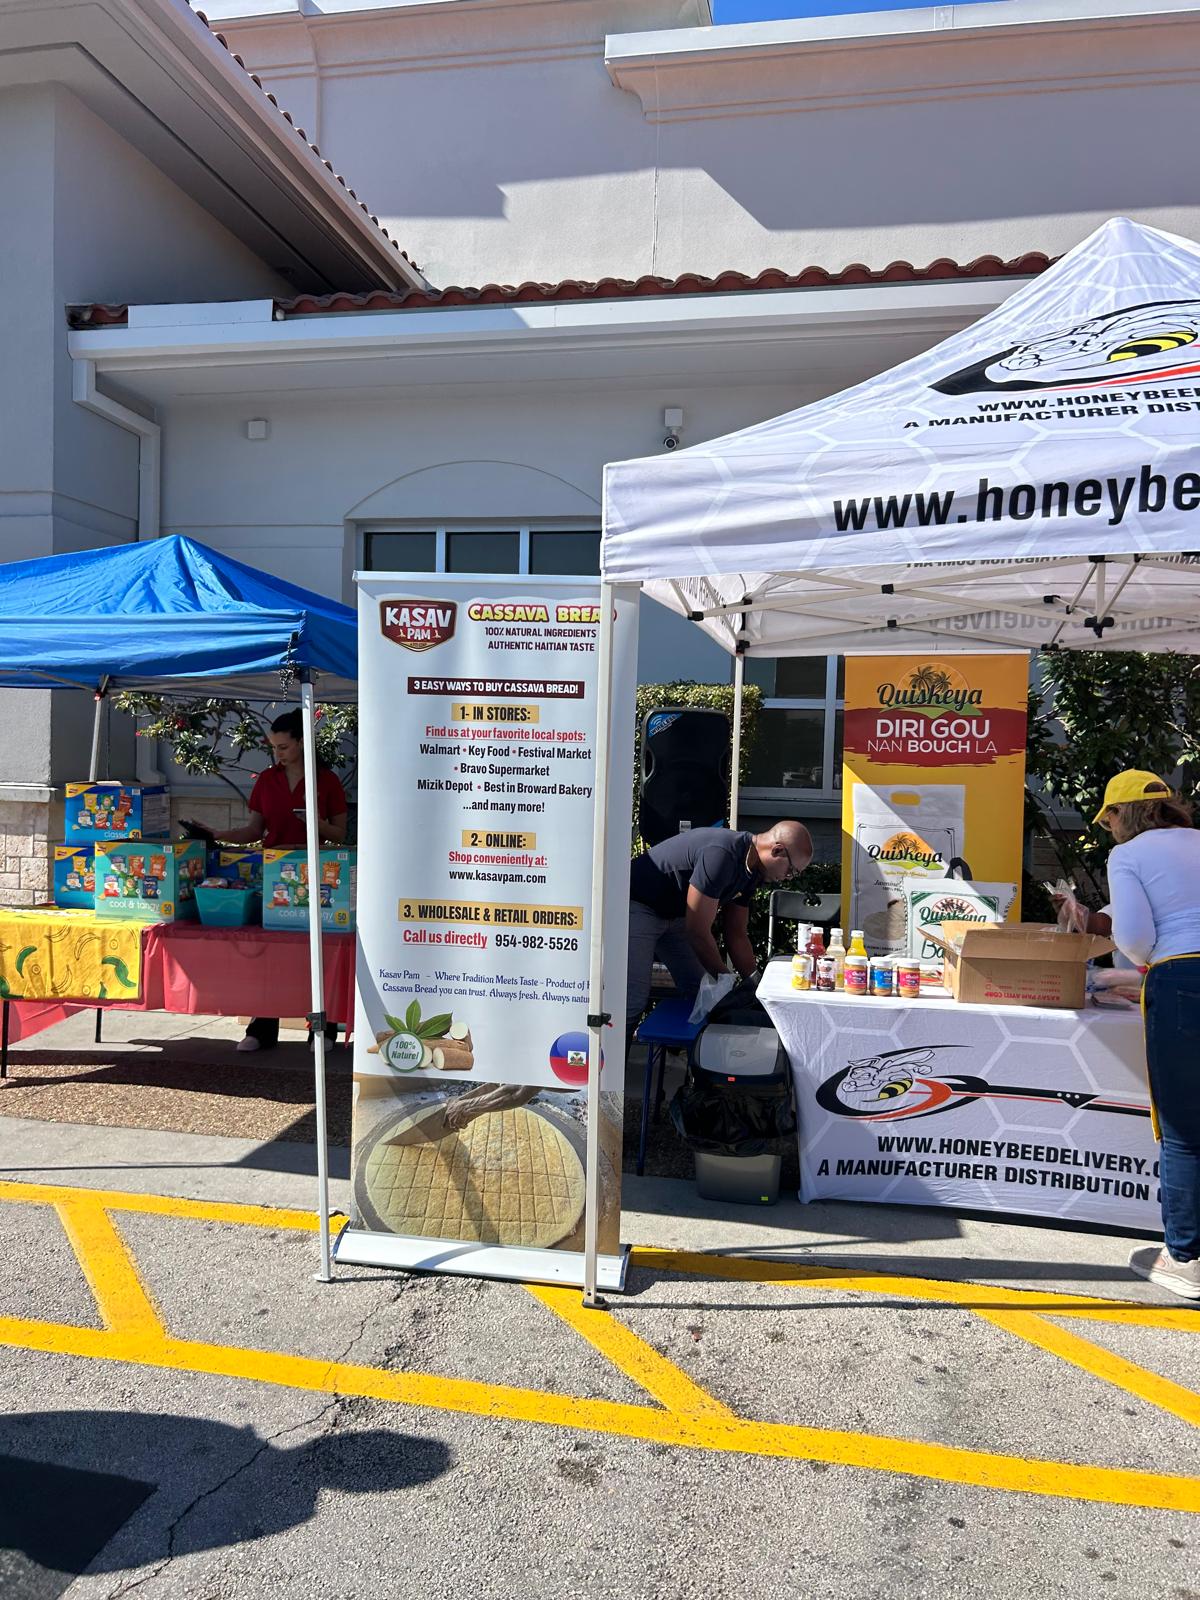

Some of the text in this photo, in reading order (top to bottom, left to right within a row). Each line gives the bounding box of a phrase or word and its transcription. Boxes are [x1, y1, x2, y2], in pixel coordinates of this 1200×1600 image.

[928, 405, 1139, 426] MANUFACTURER
[833, 465, 1200, 531] www.honeybe
[385, 607, 452, 628] KASAV
[468, 604, 618, 624] CASSAVA BREA
[407, 628, 431, 640] PAM
[485, 627, 597, 638] 100% NATURAL INGREDIENTS
[488, 641, 595, 652] AUTHENTIC HAITIAN TASTE
[414, 681, 579, 694] 3 EASY WAYS TO BUY CASSAVA BREAD!
[877, 683, 983, 711] Quiskeya
[460, 706, 531, 721] 1- IN STORES:
[425, 726, 587, 742] Find us at your favorite local spots:
[876, 718, 990, 739] DIRI GOU
[420, 743, 592, 760] Walmart Key Food Festival Market
[867, 740, 998, 754] NAN BOUCH LA
[460, 763, 550, 777] Bravo Supermarket
[417, 779, 593, 798] Mizik Depot Best in Broward Bakery
[463, 799, 545, 814] ...and many more!
[104, 831, 129, 839] classic
[471, 832, 527, 848] 2- ONLINE:
[448, 850, 548, 867] Shop conveniently at:
[868, 844, 943, 867] Quiskeya
[449, 869, 546, 884] www.kasavpam.com
[109, 900, 127, 908] cool
[404, 904, 578, 926] 3. WHOLESALE & RETAIL ORDERS:
[403, 929, 578, 951] Call us directly 954-982-5526
[379, 969, 402, 979] Kasav
[403, 969, 420, 980] Pam
[435, 971, 460, 981] Where
[462, 972, 494, 983] Tradition
[495, 975, 518, 985] Meets
[519, 976, 539, 986] Taste
[546, 978, 576, 988] Product
[577, 980, 585, 990] of
[382, 982, 413, 993] Cassava
[414, 984, 437, 994] Bread
[439, 988, 452, 996] you
[454, 987, 467, 995] can
[469, 987, 488, 997] trust.
[489, 988, 517, 1001] Always
[518, 990, 540, 1000] fresh.
[542, 991, 570, 1004] Always
[395, 1040, 416, 1049] 100%
[817, 1159, 830, 1176] A
[836, 1159, 998, 1181] MANUFACTURER
[1004, 1166, 1149, 1201] DISTRIBUTION
